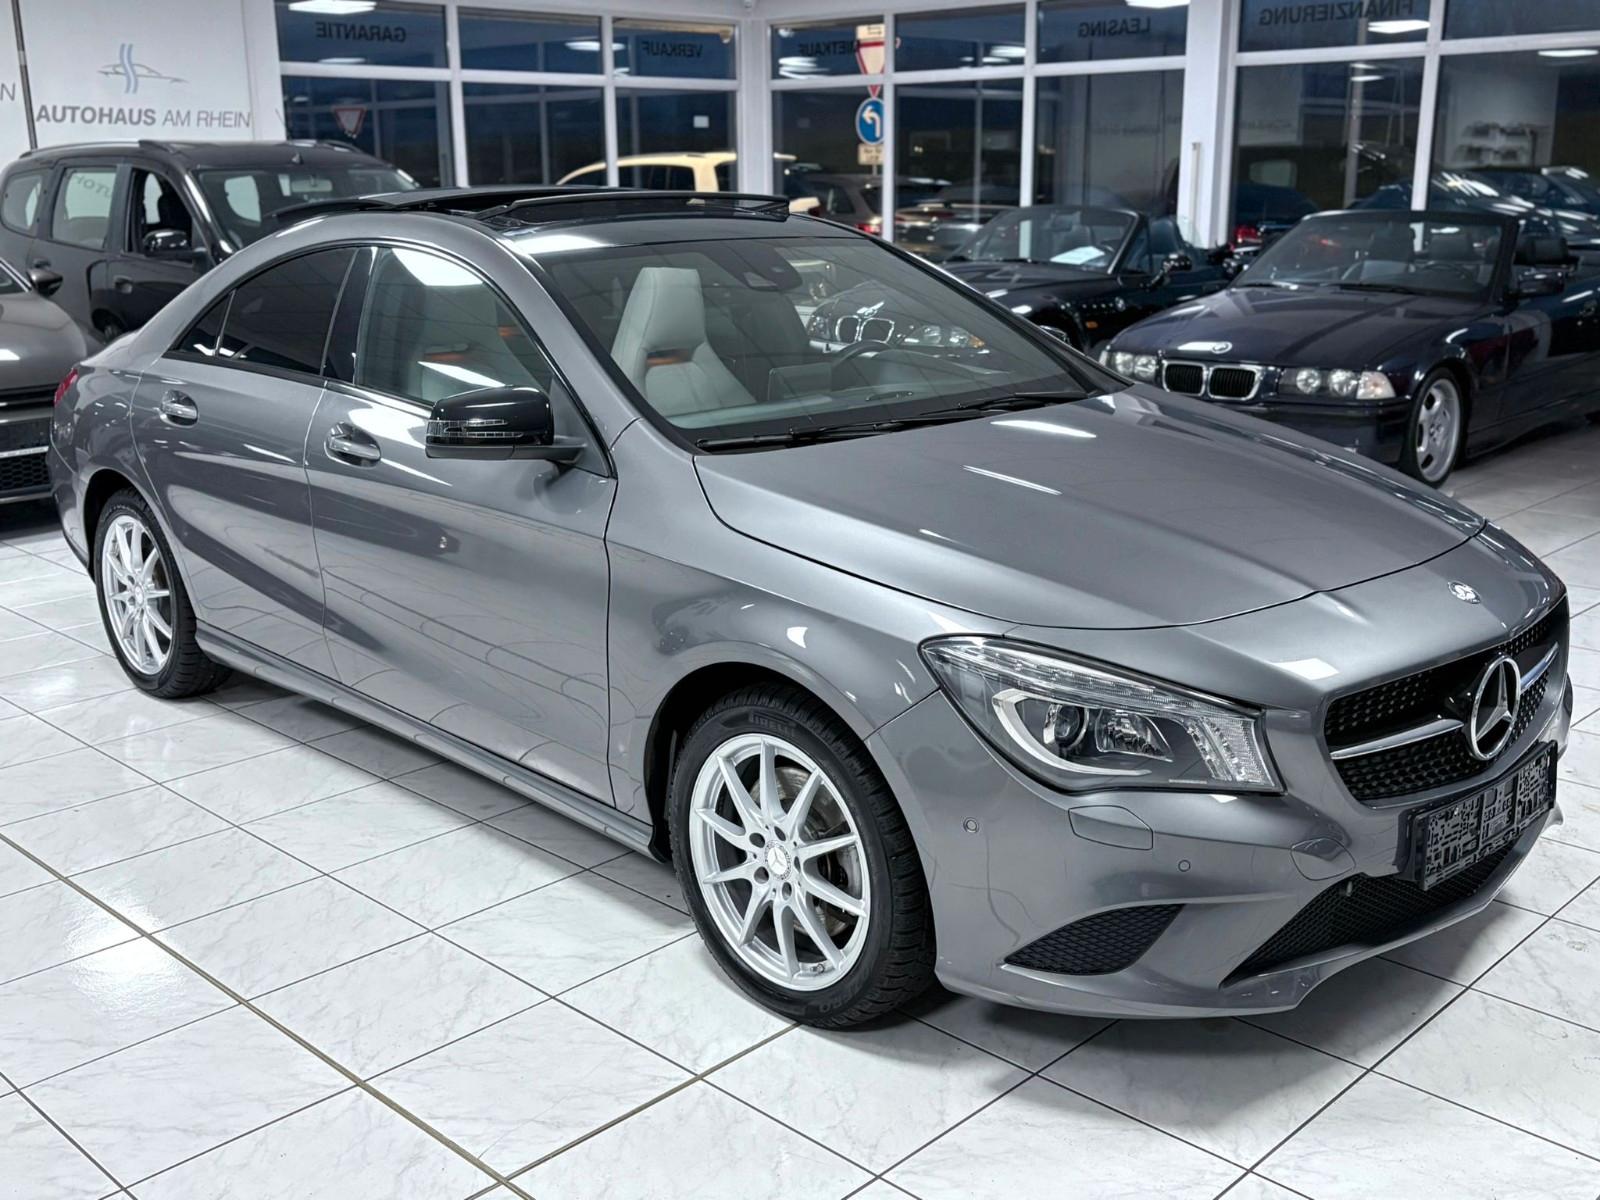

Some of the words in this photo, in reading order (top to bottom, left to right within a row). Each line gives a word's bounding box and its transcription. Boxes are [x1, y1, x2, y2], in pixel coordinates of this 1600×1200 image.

[36, 105, 156, 126] AUTOHAUS
[162, 109, 190, 127] AM
[197, 110, 250, 128] RHEIN
